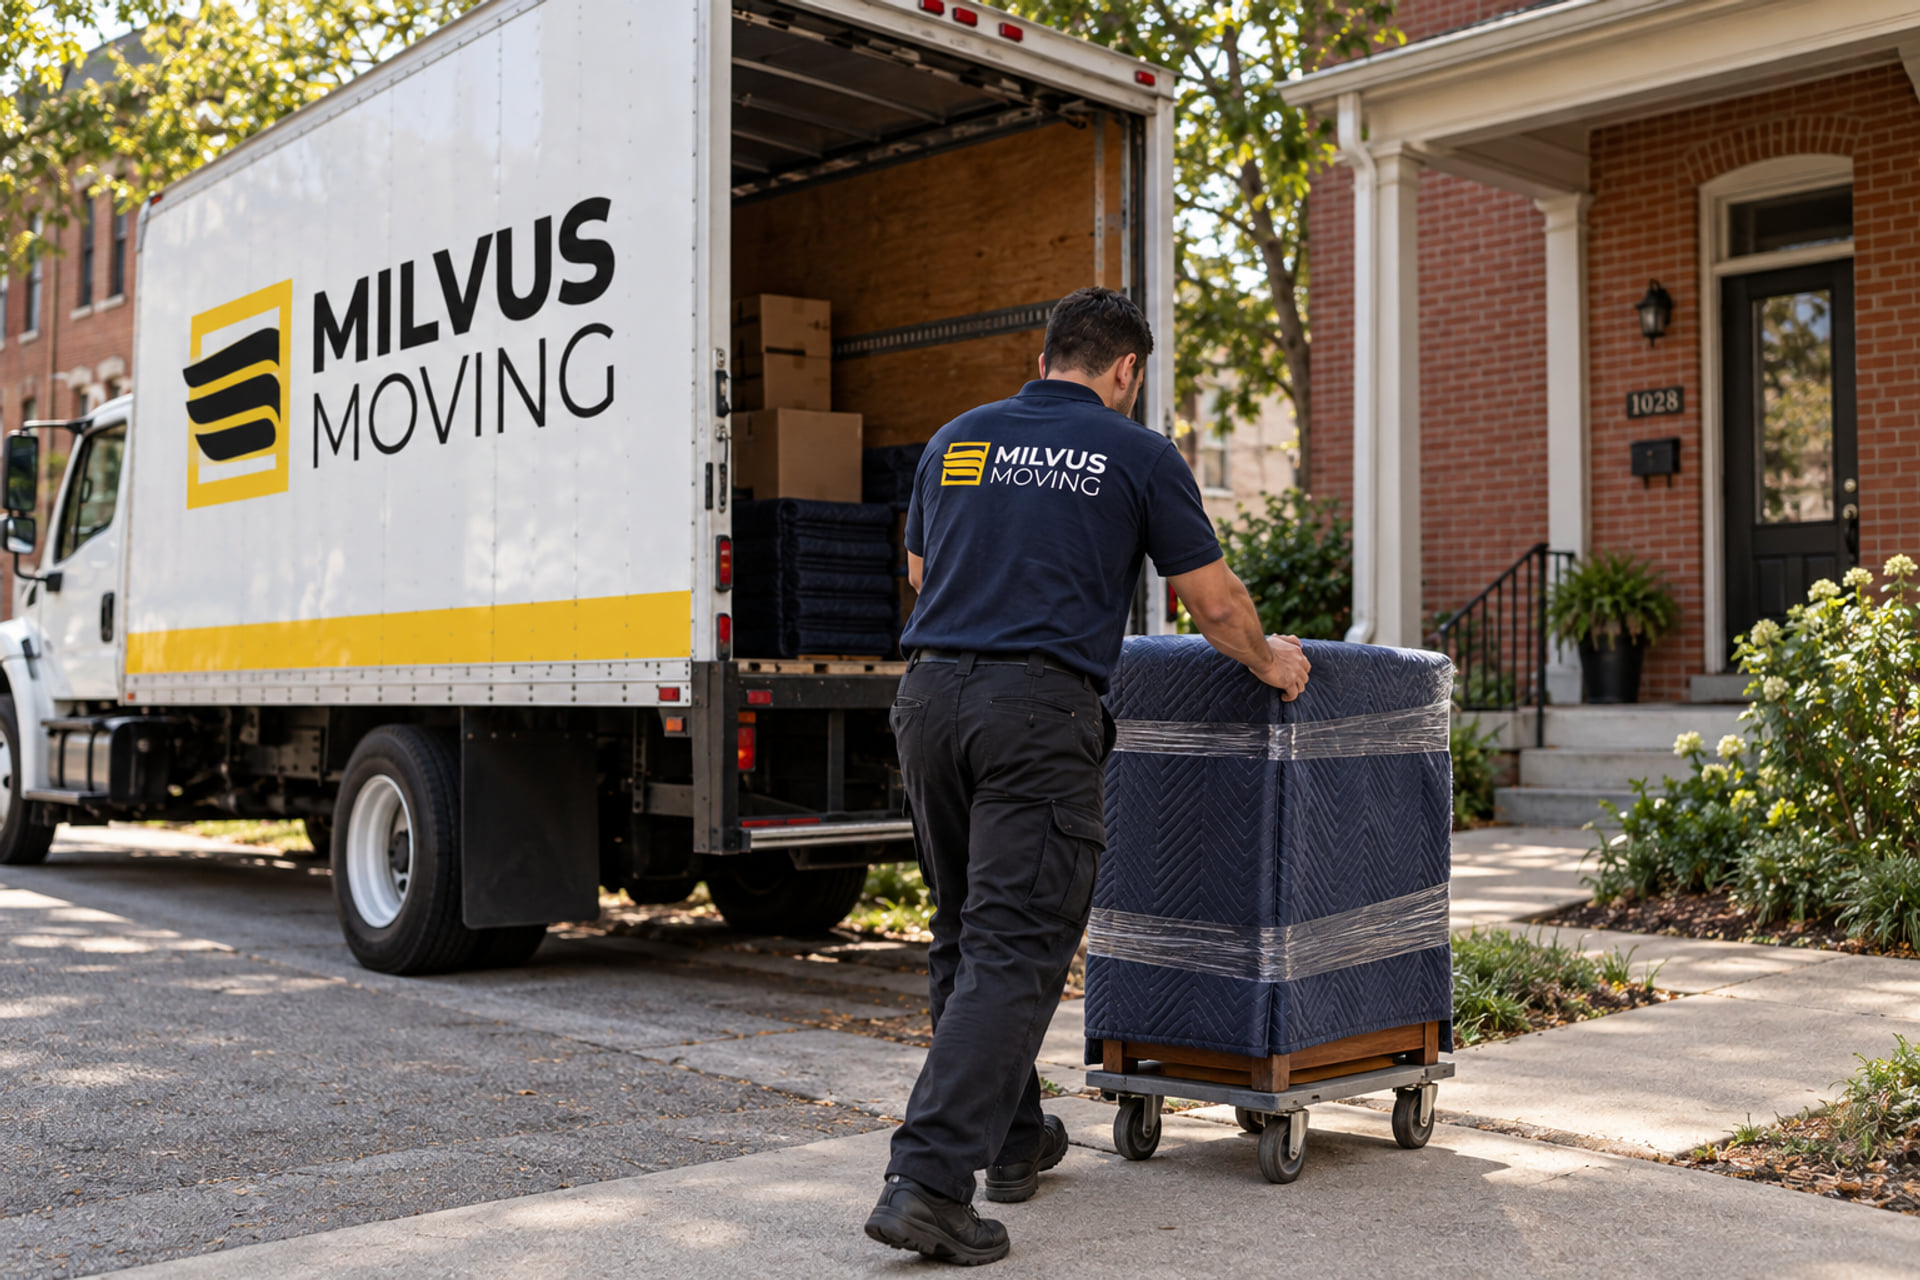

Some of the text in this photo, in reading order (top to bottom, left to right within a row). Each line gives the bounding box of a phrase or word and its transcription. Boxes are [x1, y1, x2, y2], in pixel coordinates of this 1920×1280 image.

[313, 196, 616, 374] MILVUS
[313, 322, 616, 469] MOVING
[1632, 389, 1679, 415] 1028
[994, 445, 1108, 474] MILVUS
[989, 466, 1101, 497] MOVING
